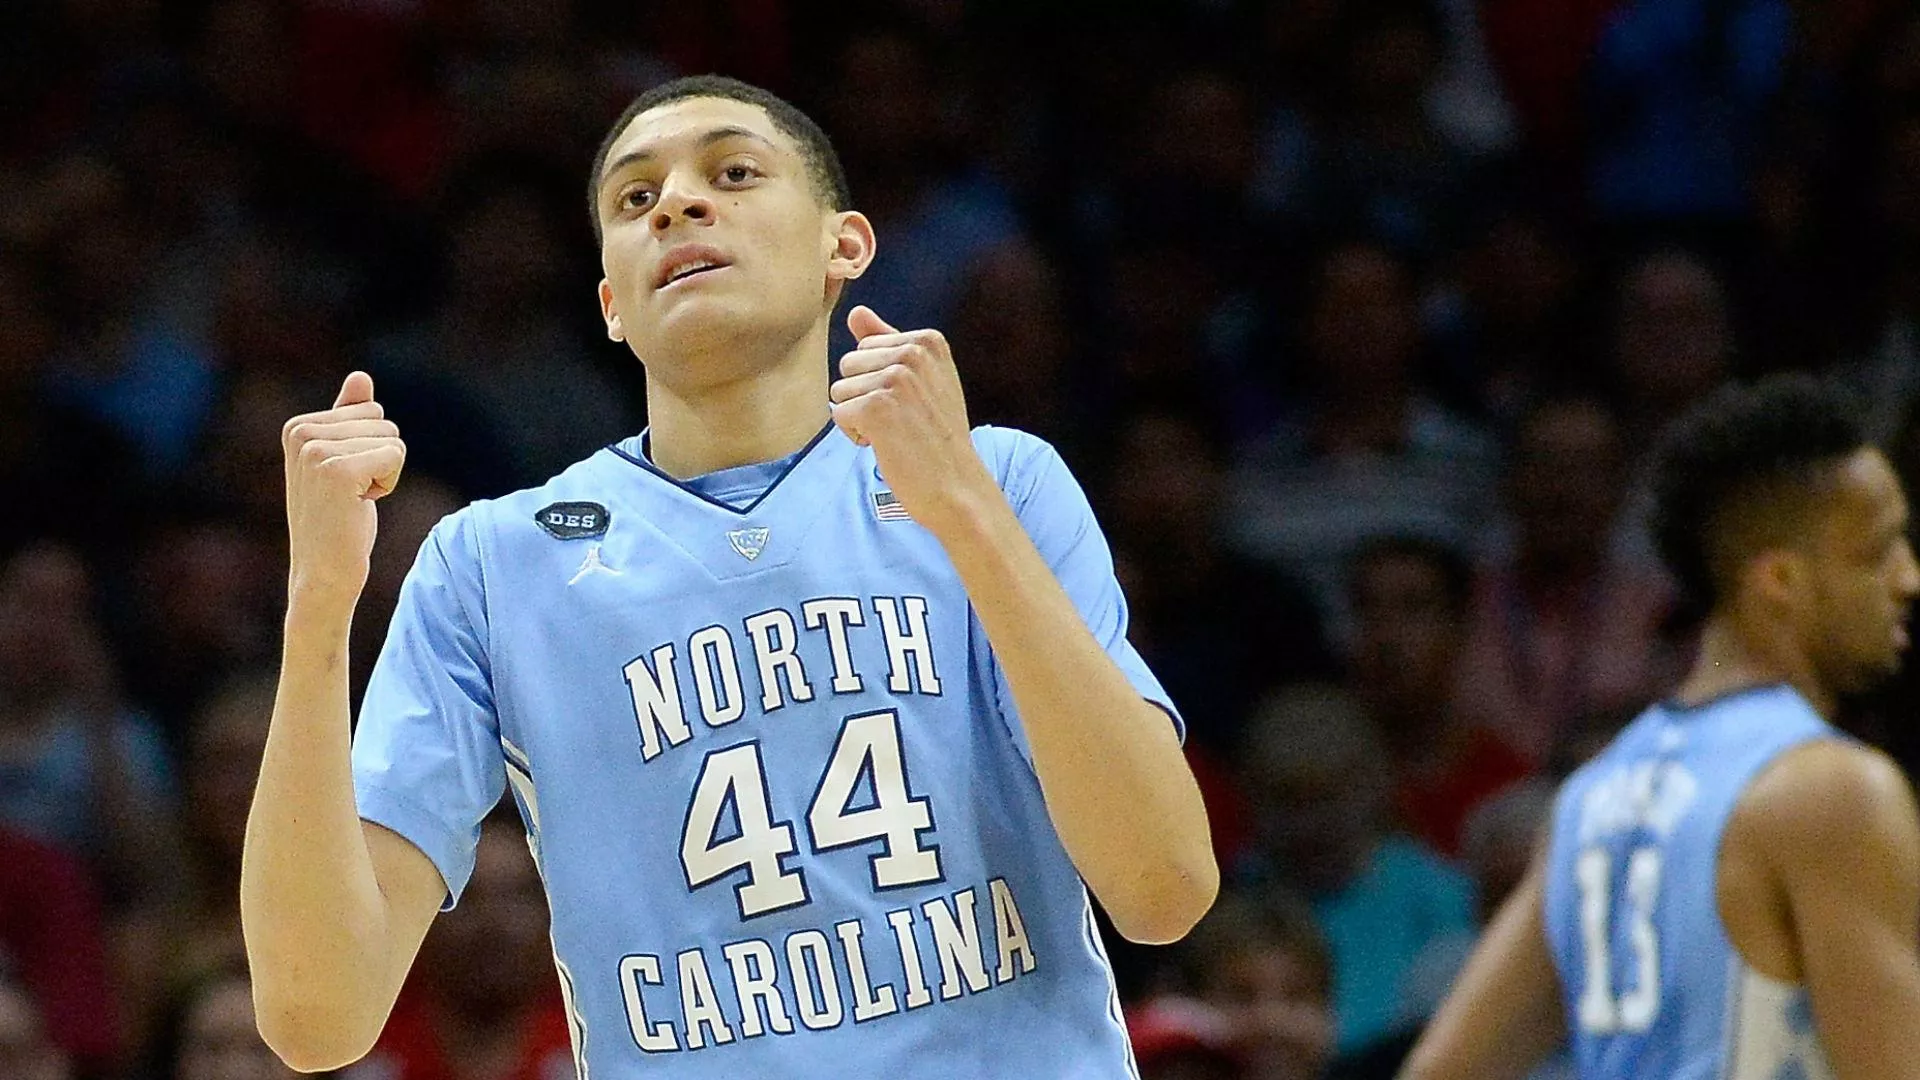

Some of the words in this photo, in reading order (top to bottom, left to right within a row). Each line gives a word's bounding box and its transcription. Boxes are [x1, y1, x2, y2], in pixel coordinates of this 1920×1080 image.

[546, 513, 595, 528] DES
[622, 596, 942, 763] NORTH
[679, 707, 945, 921] 44
[618, 877, 1037, 1054] CAROLINA
